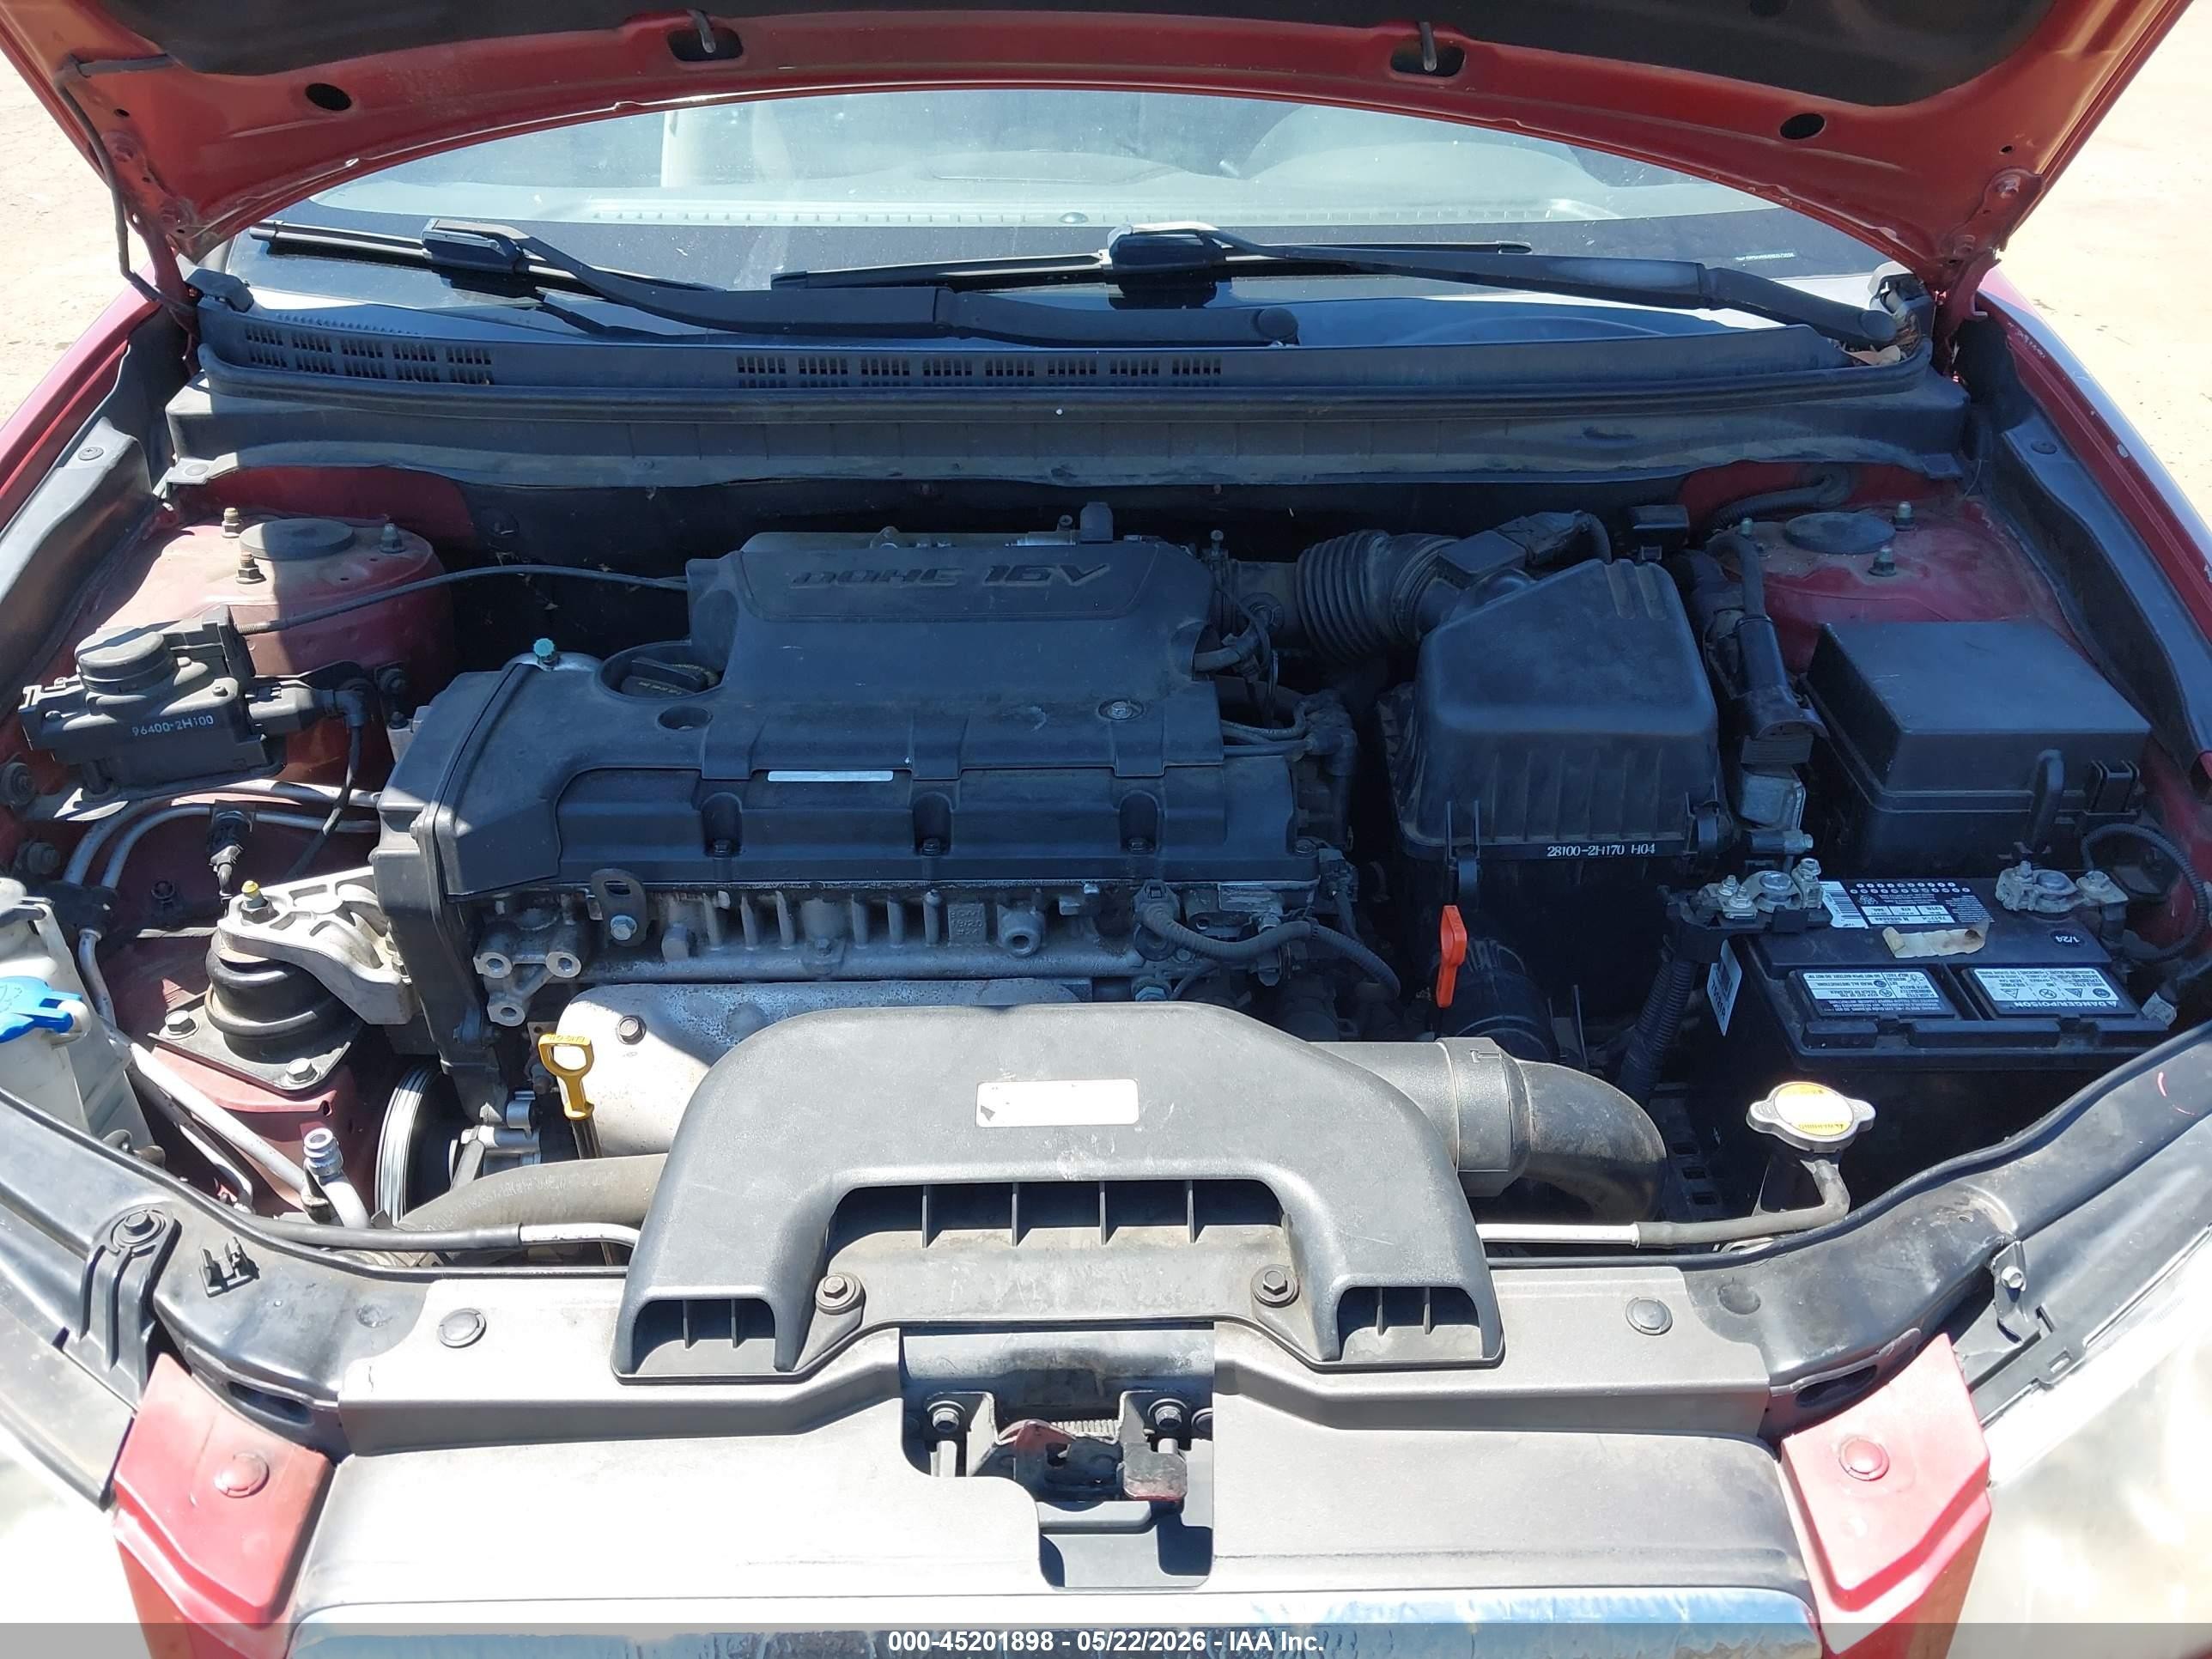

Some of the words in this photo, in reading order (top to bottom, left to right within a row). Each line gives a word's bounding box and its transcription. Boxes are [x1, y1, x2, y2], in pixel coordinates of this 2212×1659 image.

[790, 566, 965, 590] DOHC
[983, 562, 1111, 588] 16V
[131, 715, 214, 736] 96400-2H100
[1547, 844, 1625, 857] 28100-2H170
[1631, 842, 1656, 855] H04
[2055, 935, 2081, 944] 1/24
